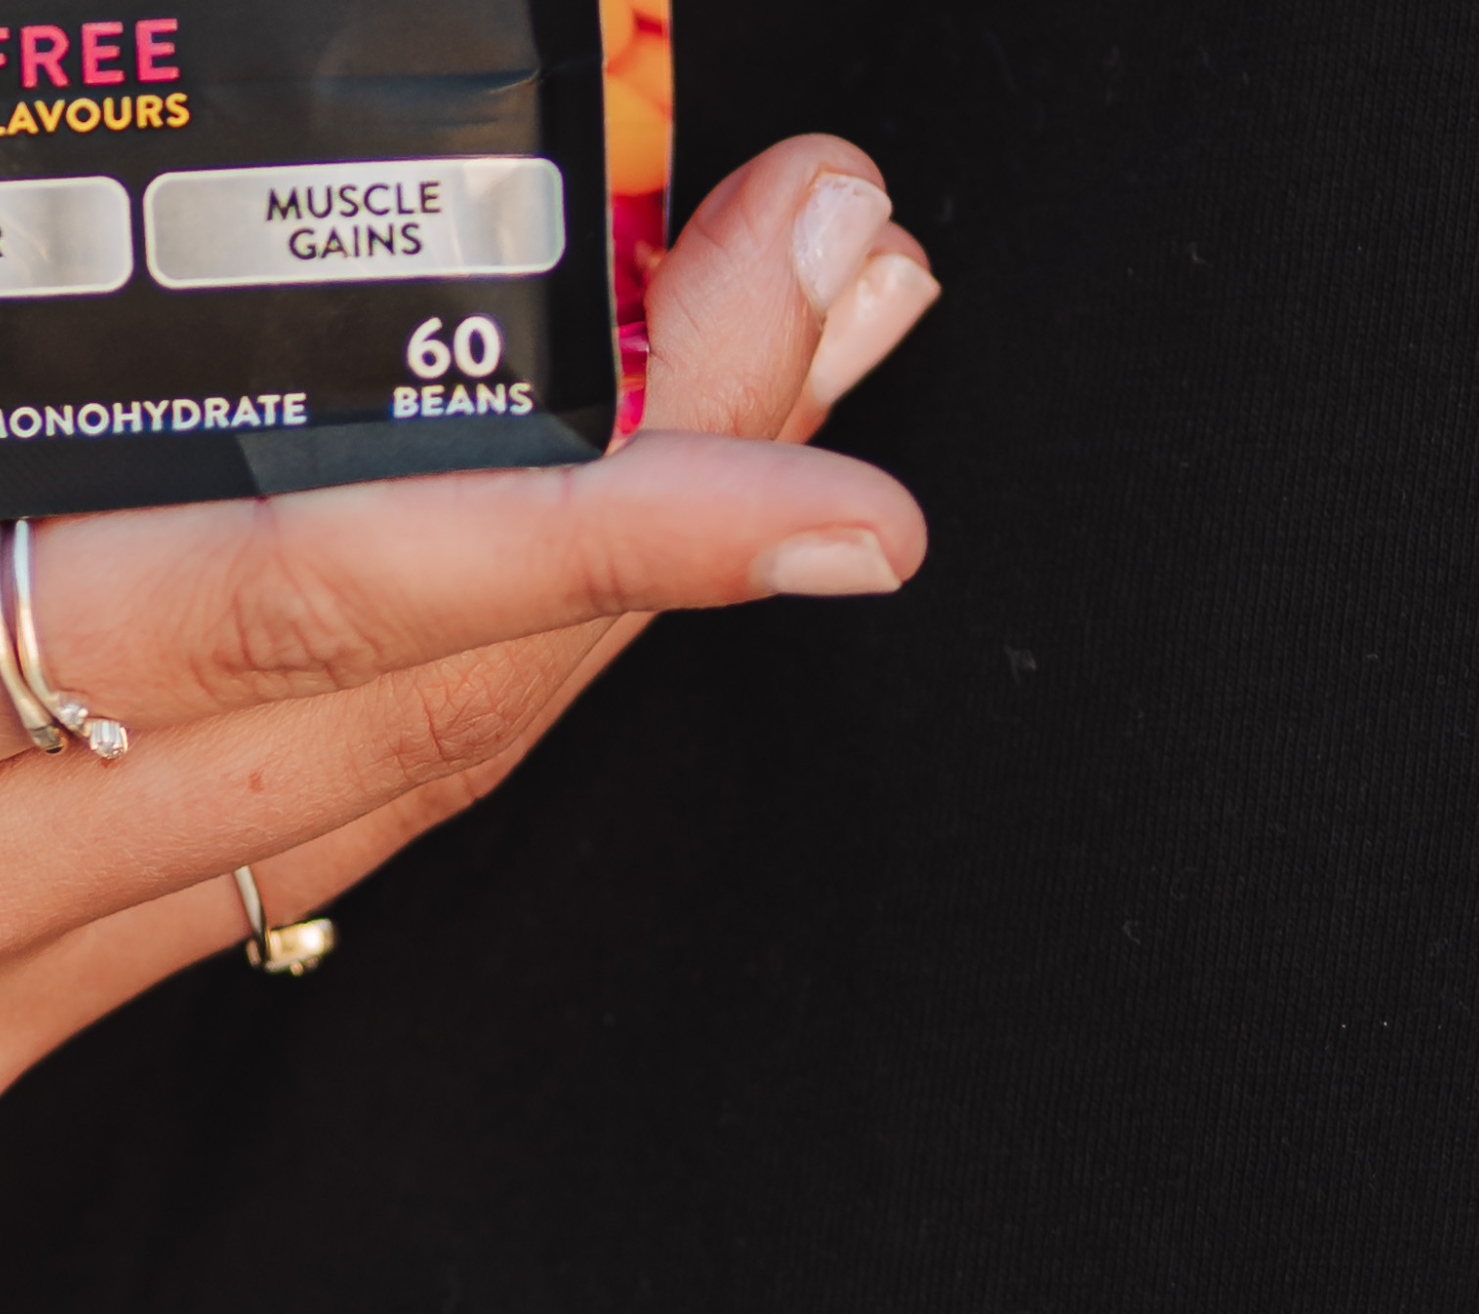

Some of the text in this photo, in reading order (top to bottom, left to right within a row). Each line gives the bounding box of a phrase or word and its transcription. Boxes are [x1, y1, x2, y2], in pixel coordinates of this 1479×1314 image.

[265, 181, 442, 223] MUSCLE
[288, 222, 423, 261] GAINS
[406, 315, 502, 379] 60
[393, 382, 534, 420] BEANS
